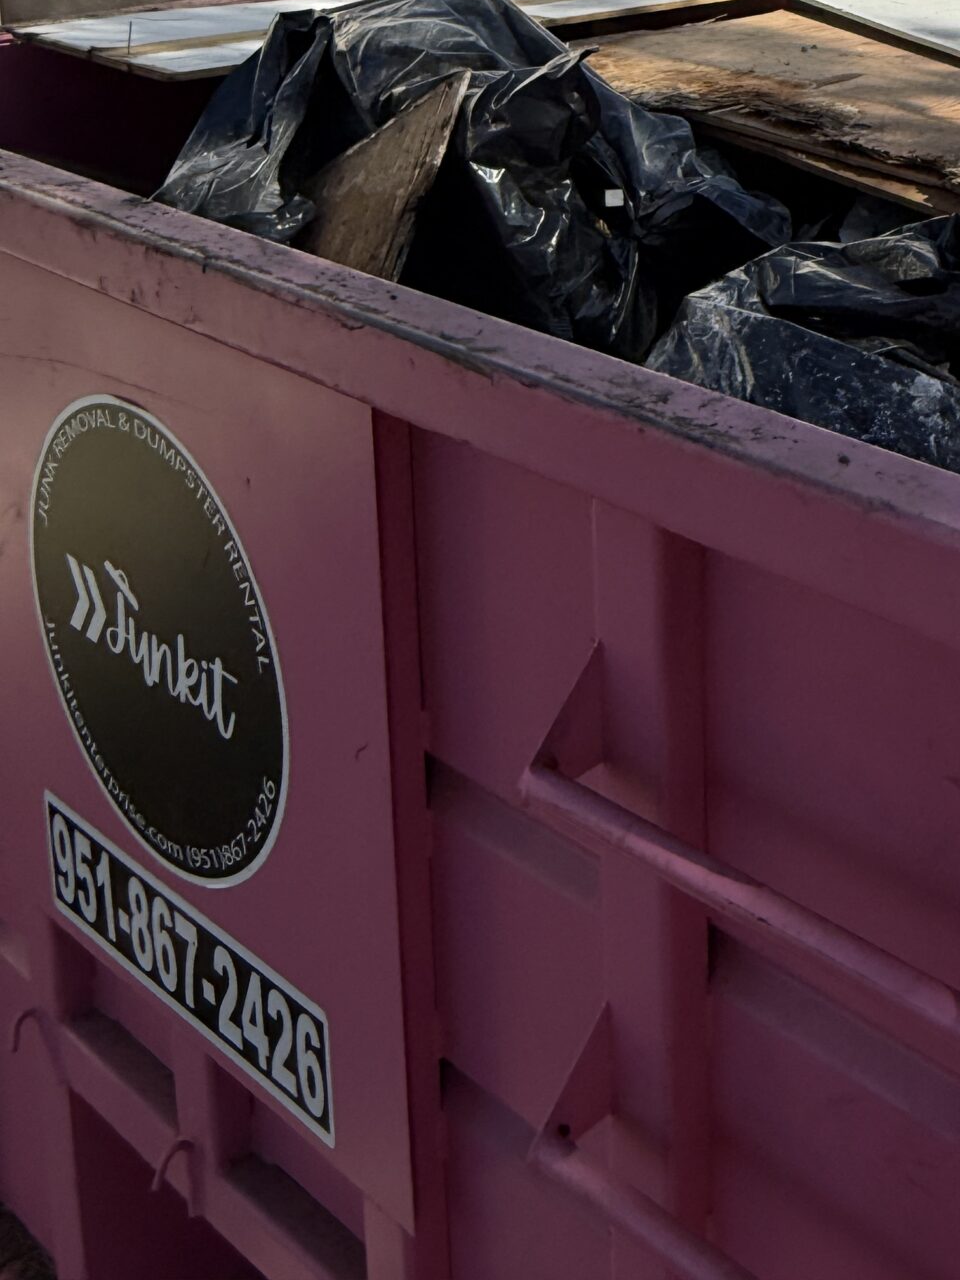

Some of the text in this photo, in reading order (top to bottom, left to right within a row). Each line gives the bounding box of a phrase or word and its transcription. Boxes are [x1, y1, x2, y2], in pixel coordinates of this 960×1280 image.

[38, 410, 270, 675] JUNK REMOVAL & DUMPSTER RENTAL
[104, 560, 239, 740] Junkit
[52, 812, 325, 1118] 951-867-2426
